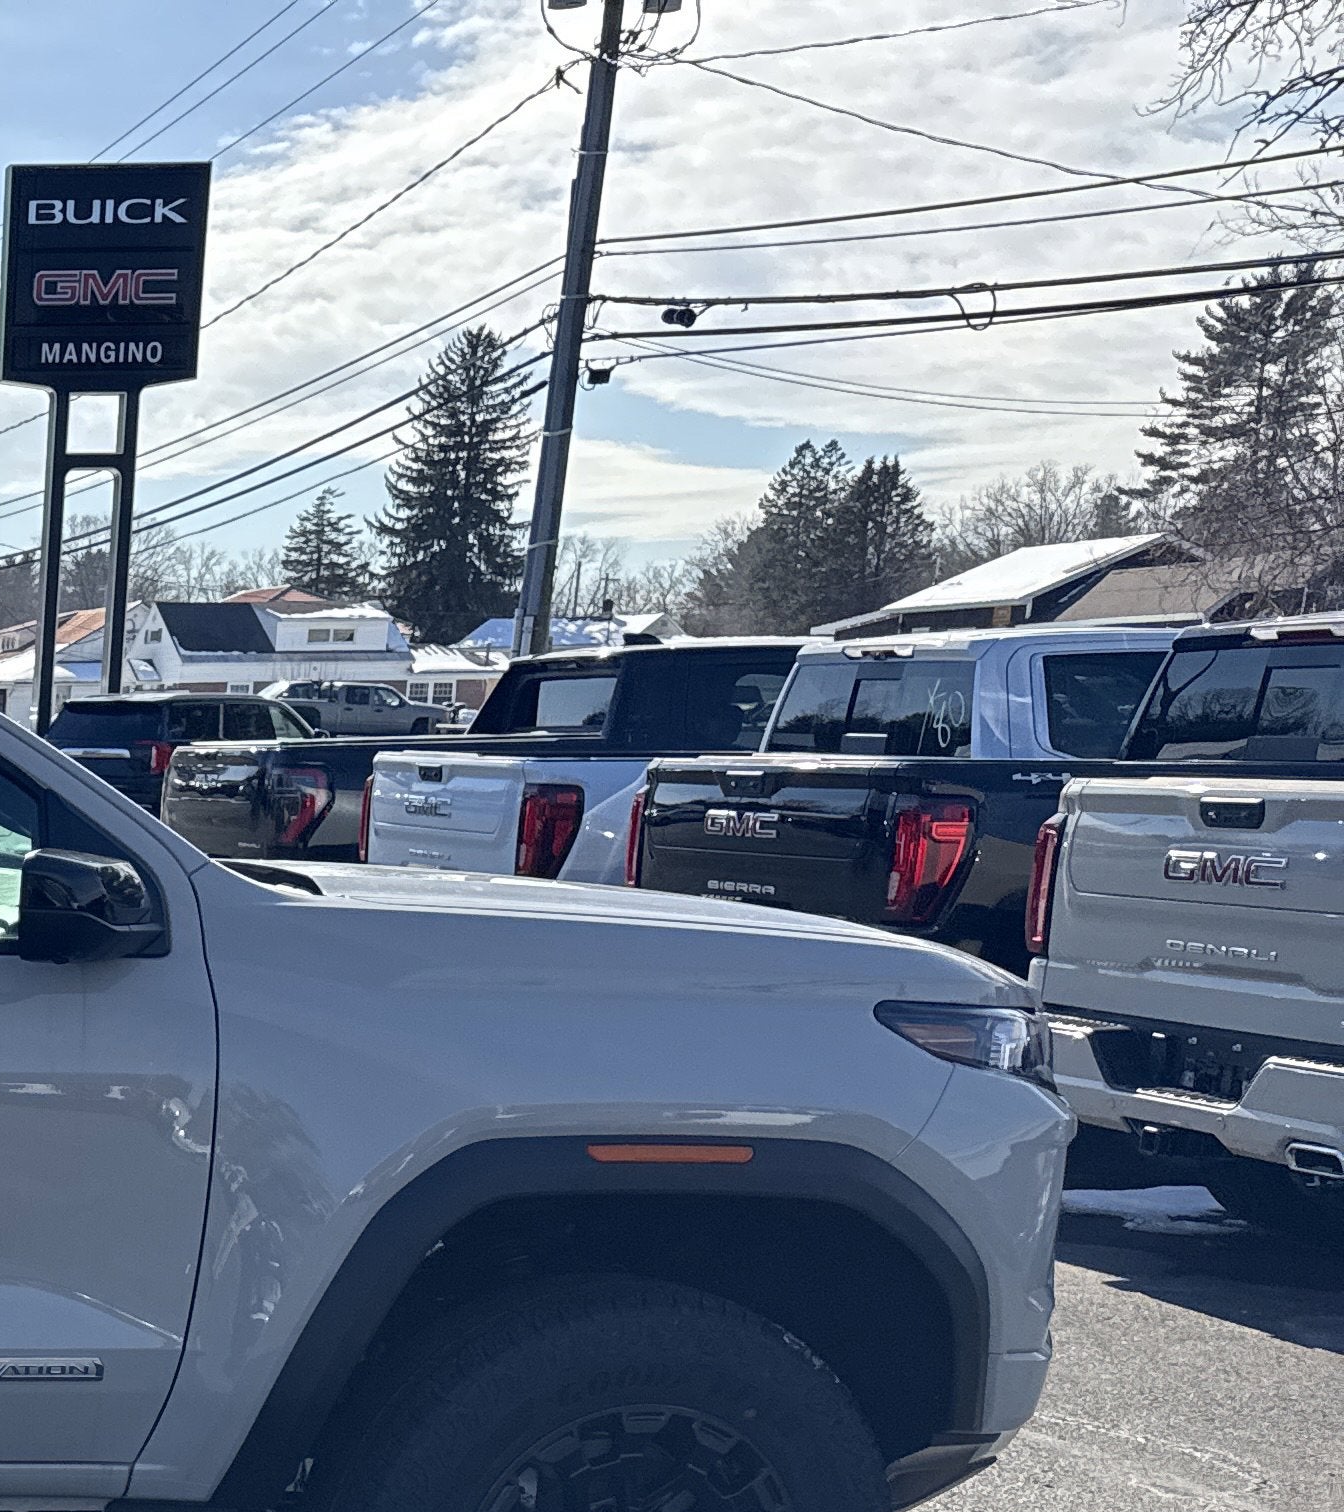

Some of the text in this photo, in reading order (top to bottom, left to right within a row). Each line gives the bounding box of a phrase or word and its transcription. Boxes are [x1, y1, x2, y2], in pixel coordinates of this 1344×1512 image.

[27, 198, 188, 225] BUICK
[33, 268, 179, 306] GMC
[40, 341, 163, 363] MANGINO
[704, 809, 780, 838] GMC
[1163, 849, 1288, 889] GMC
[707, 880, 776, 895] SIERRA
[1165, 939, 1279, 961] DENALI
